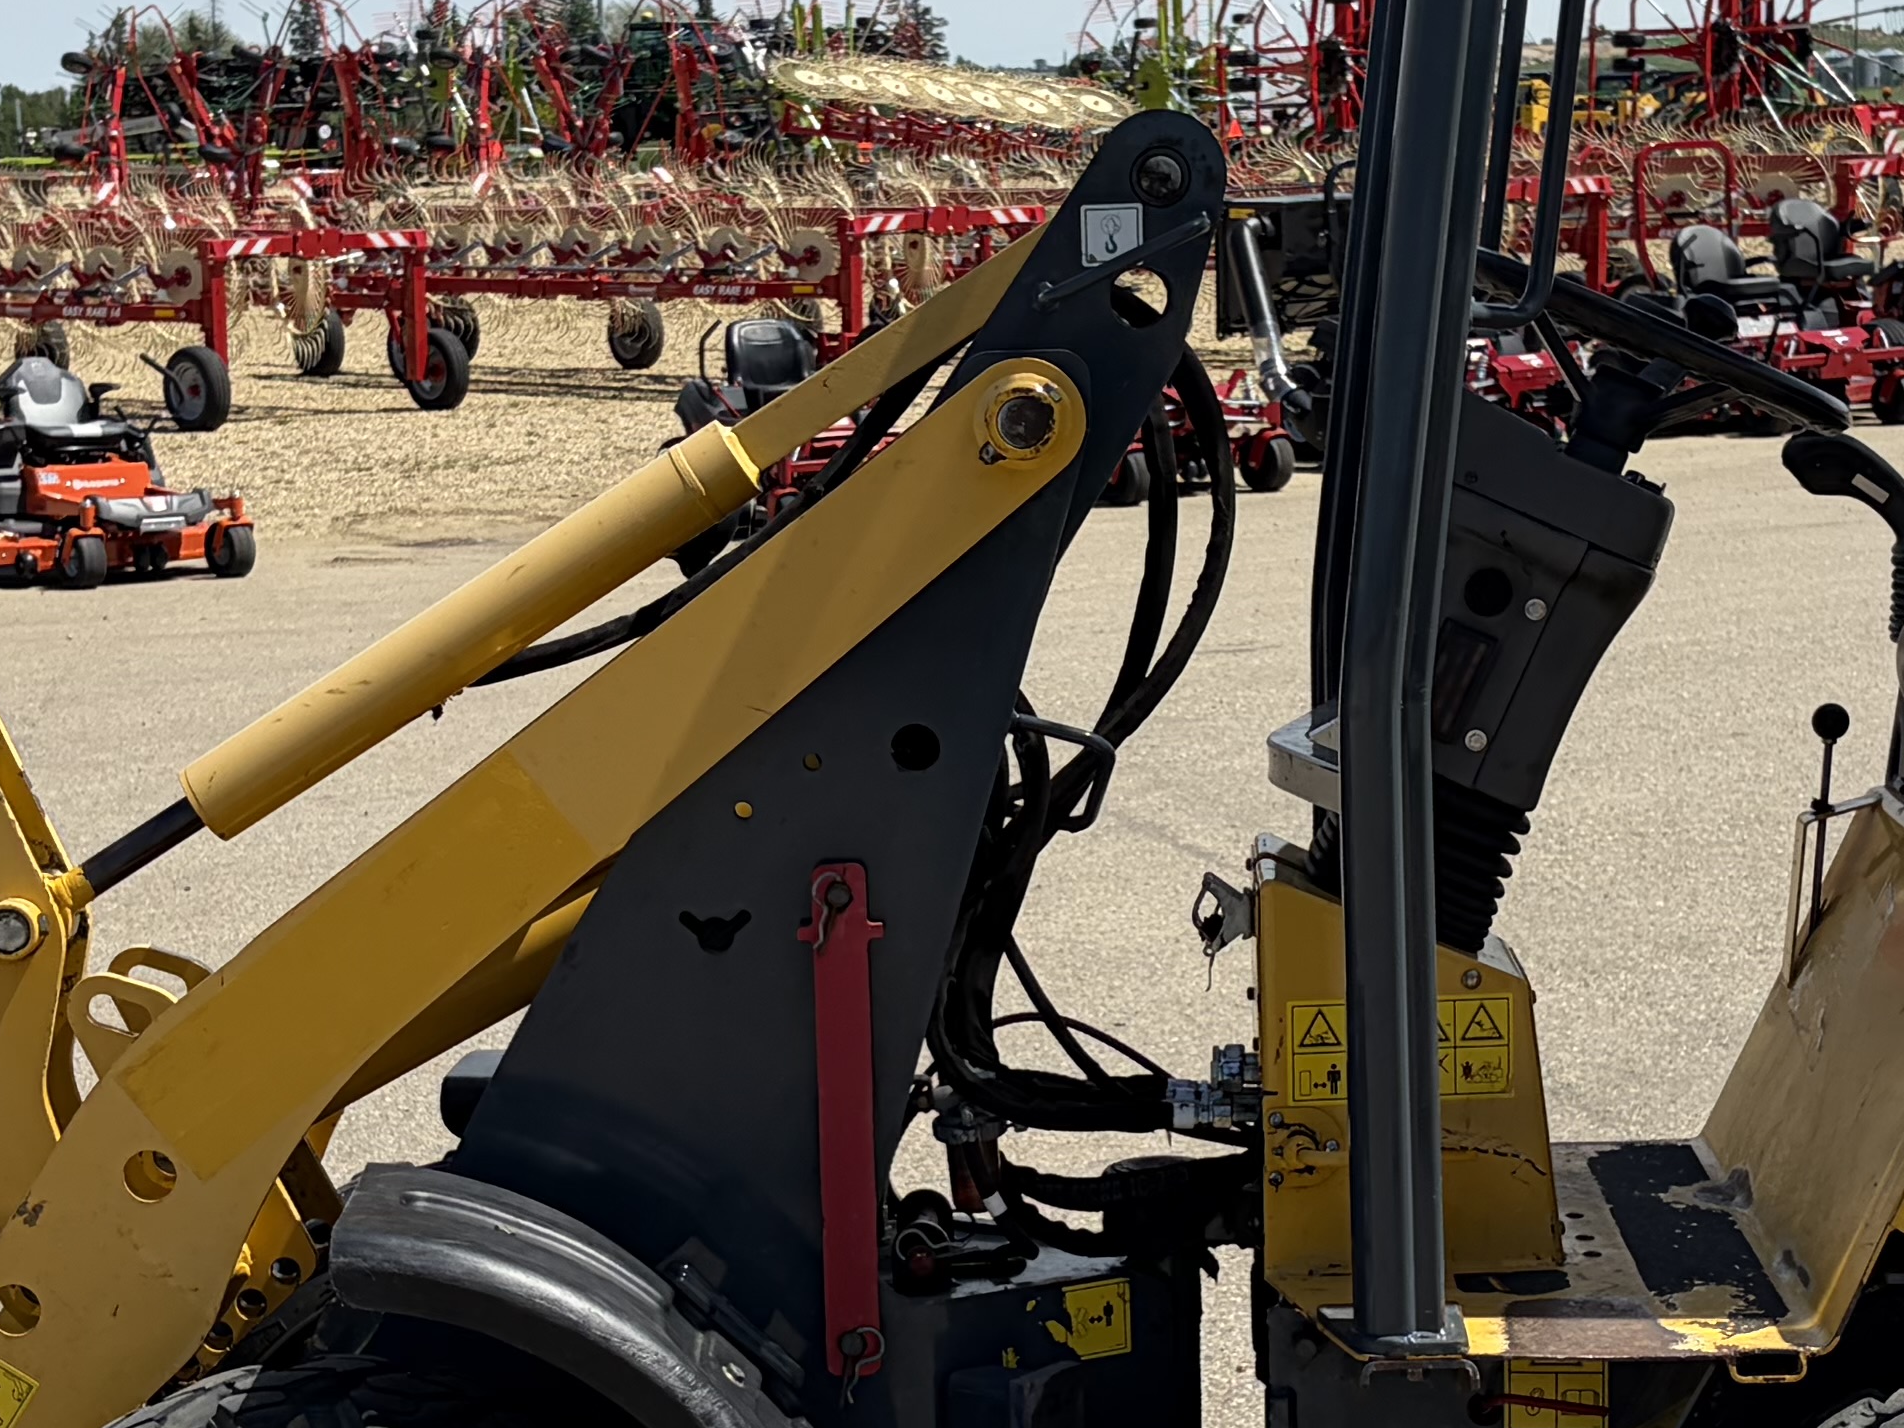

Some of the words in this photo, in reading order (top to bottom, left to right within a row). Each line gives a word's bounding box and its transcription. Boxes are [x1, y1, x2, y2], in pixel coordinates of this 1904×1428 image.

[692, 285, 716, 296] EASY
[718, 285, 742, 296] RAKE
[62, 306, 83, 317] EASY
[85, 307, 108, 317] RAKE
